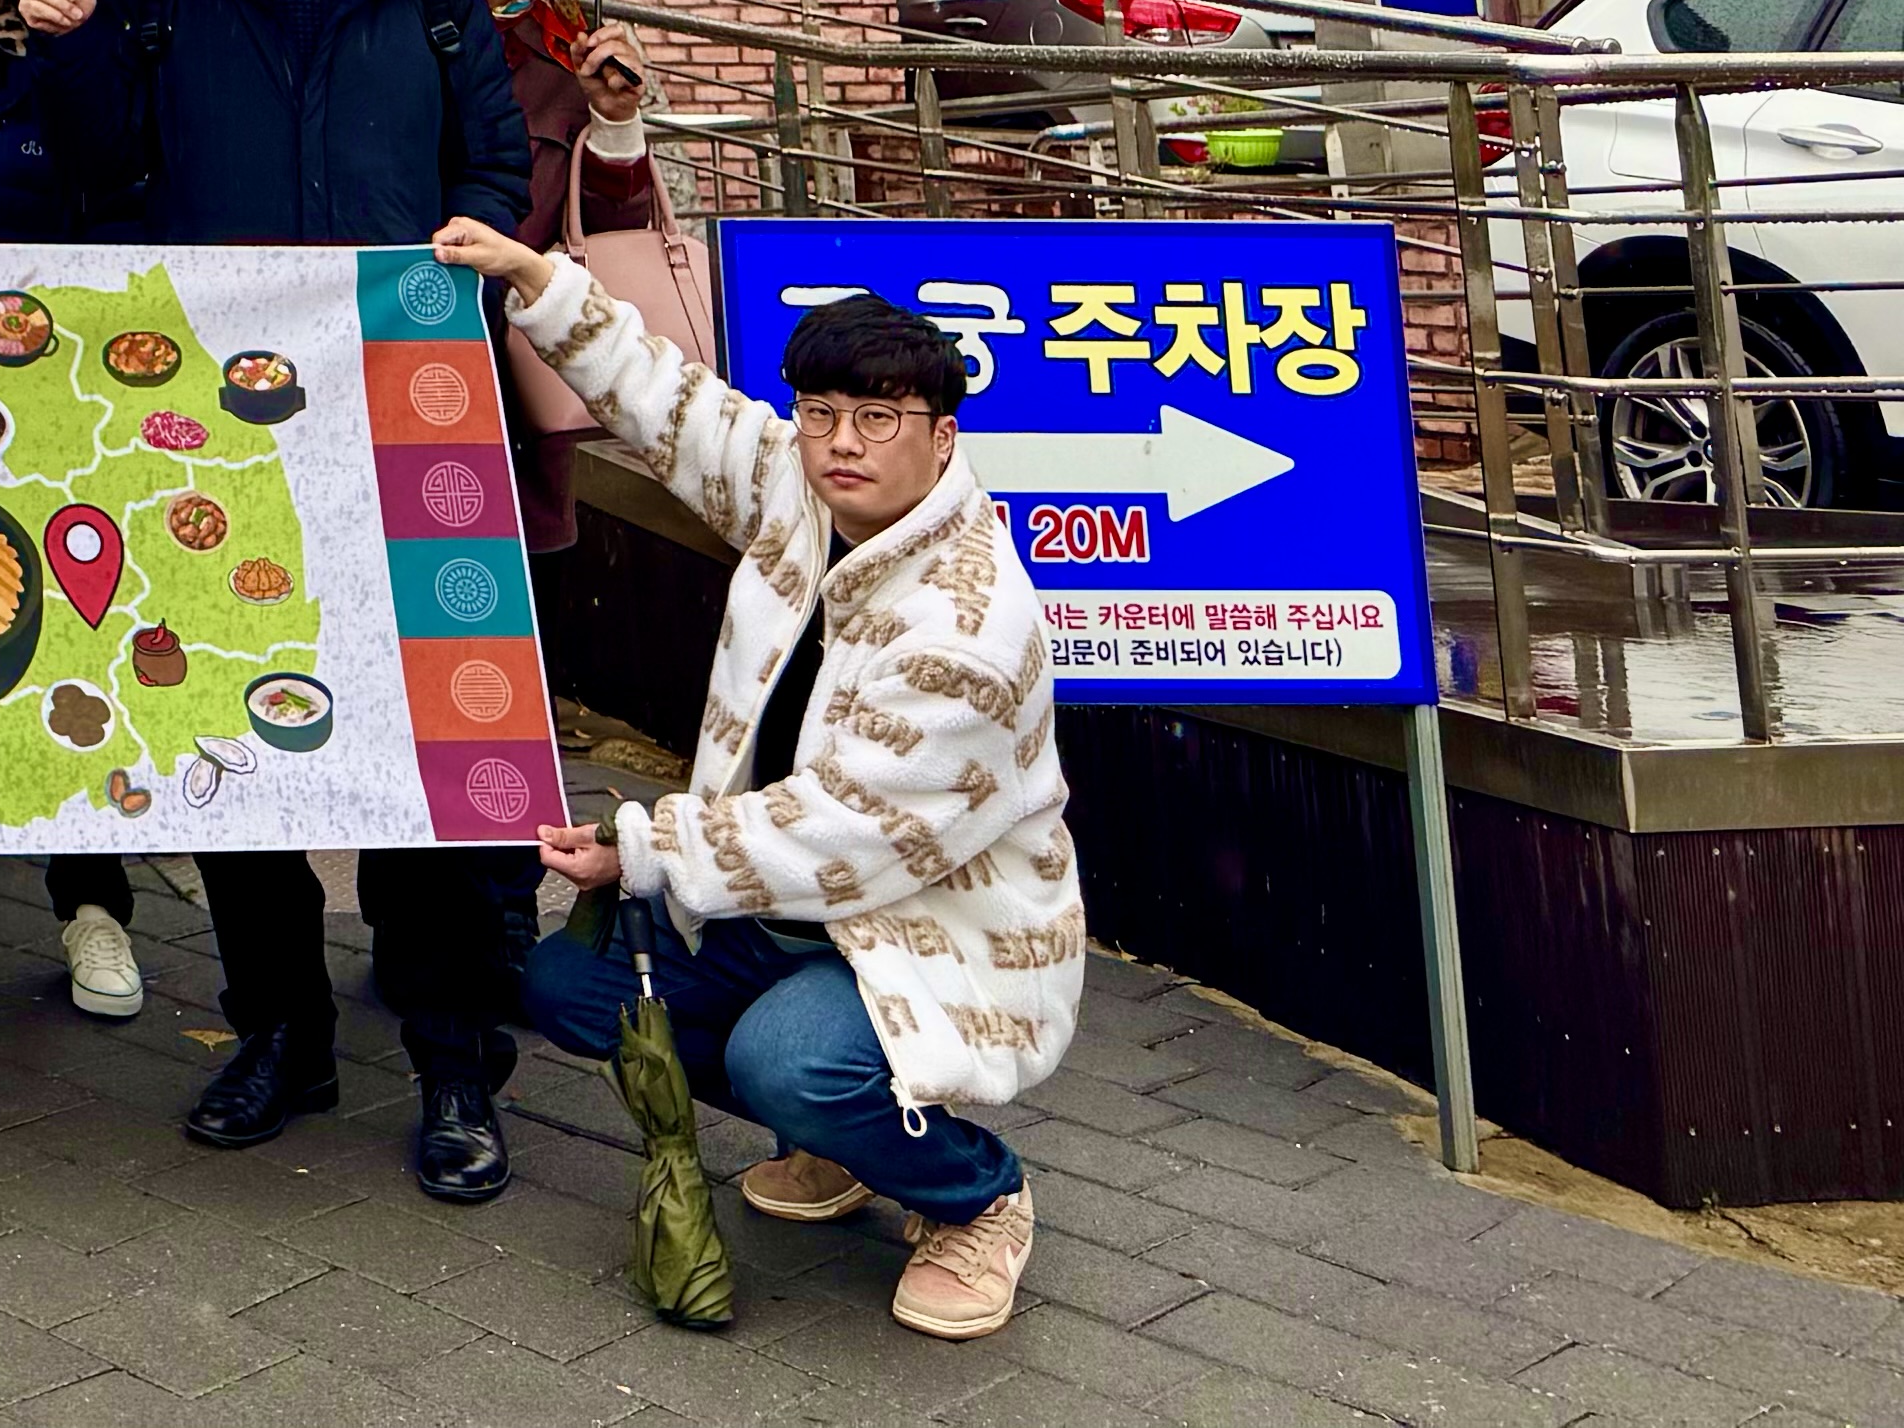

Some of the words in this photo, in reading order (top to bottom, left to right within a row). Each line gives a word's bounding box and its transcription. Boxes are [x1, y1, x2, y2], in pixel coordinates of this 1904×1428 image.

[1043, 282, 1367, 396] 주차장
[1031, 506, 1149, 561] 20M
[1098, 602, 1195, 631] 카운터에
[1204, 603, 1278, 632] 말씀해
[1287, 603, 1384, 631] 주십시요
[1129, 638, 1226, 667] 준비되어
[1237, 638, 1342, 668] 있습니다)
